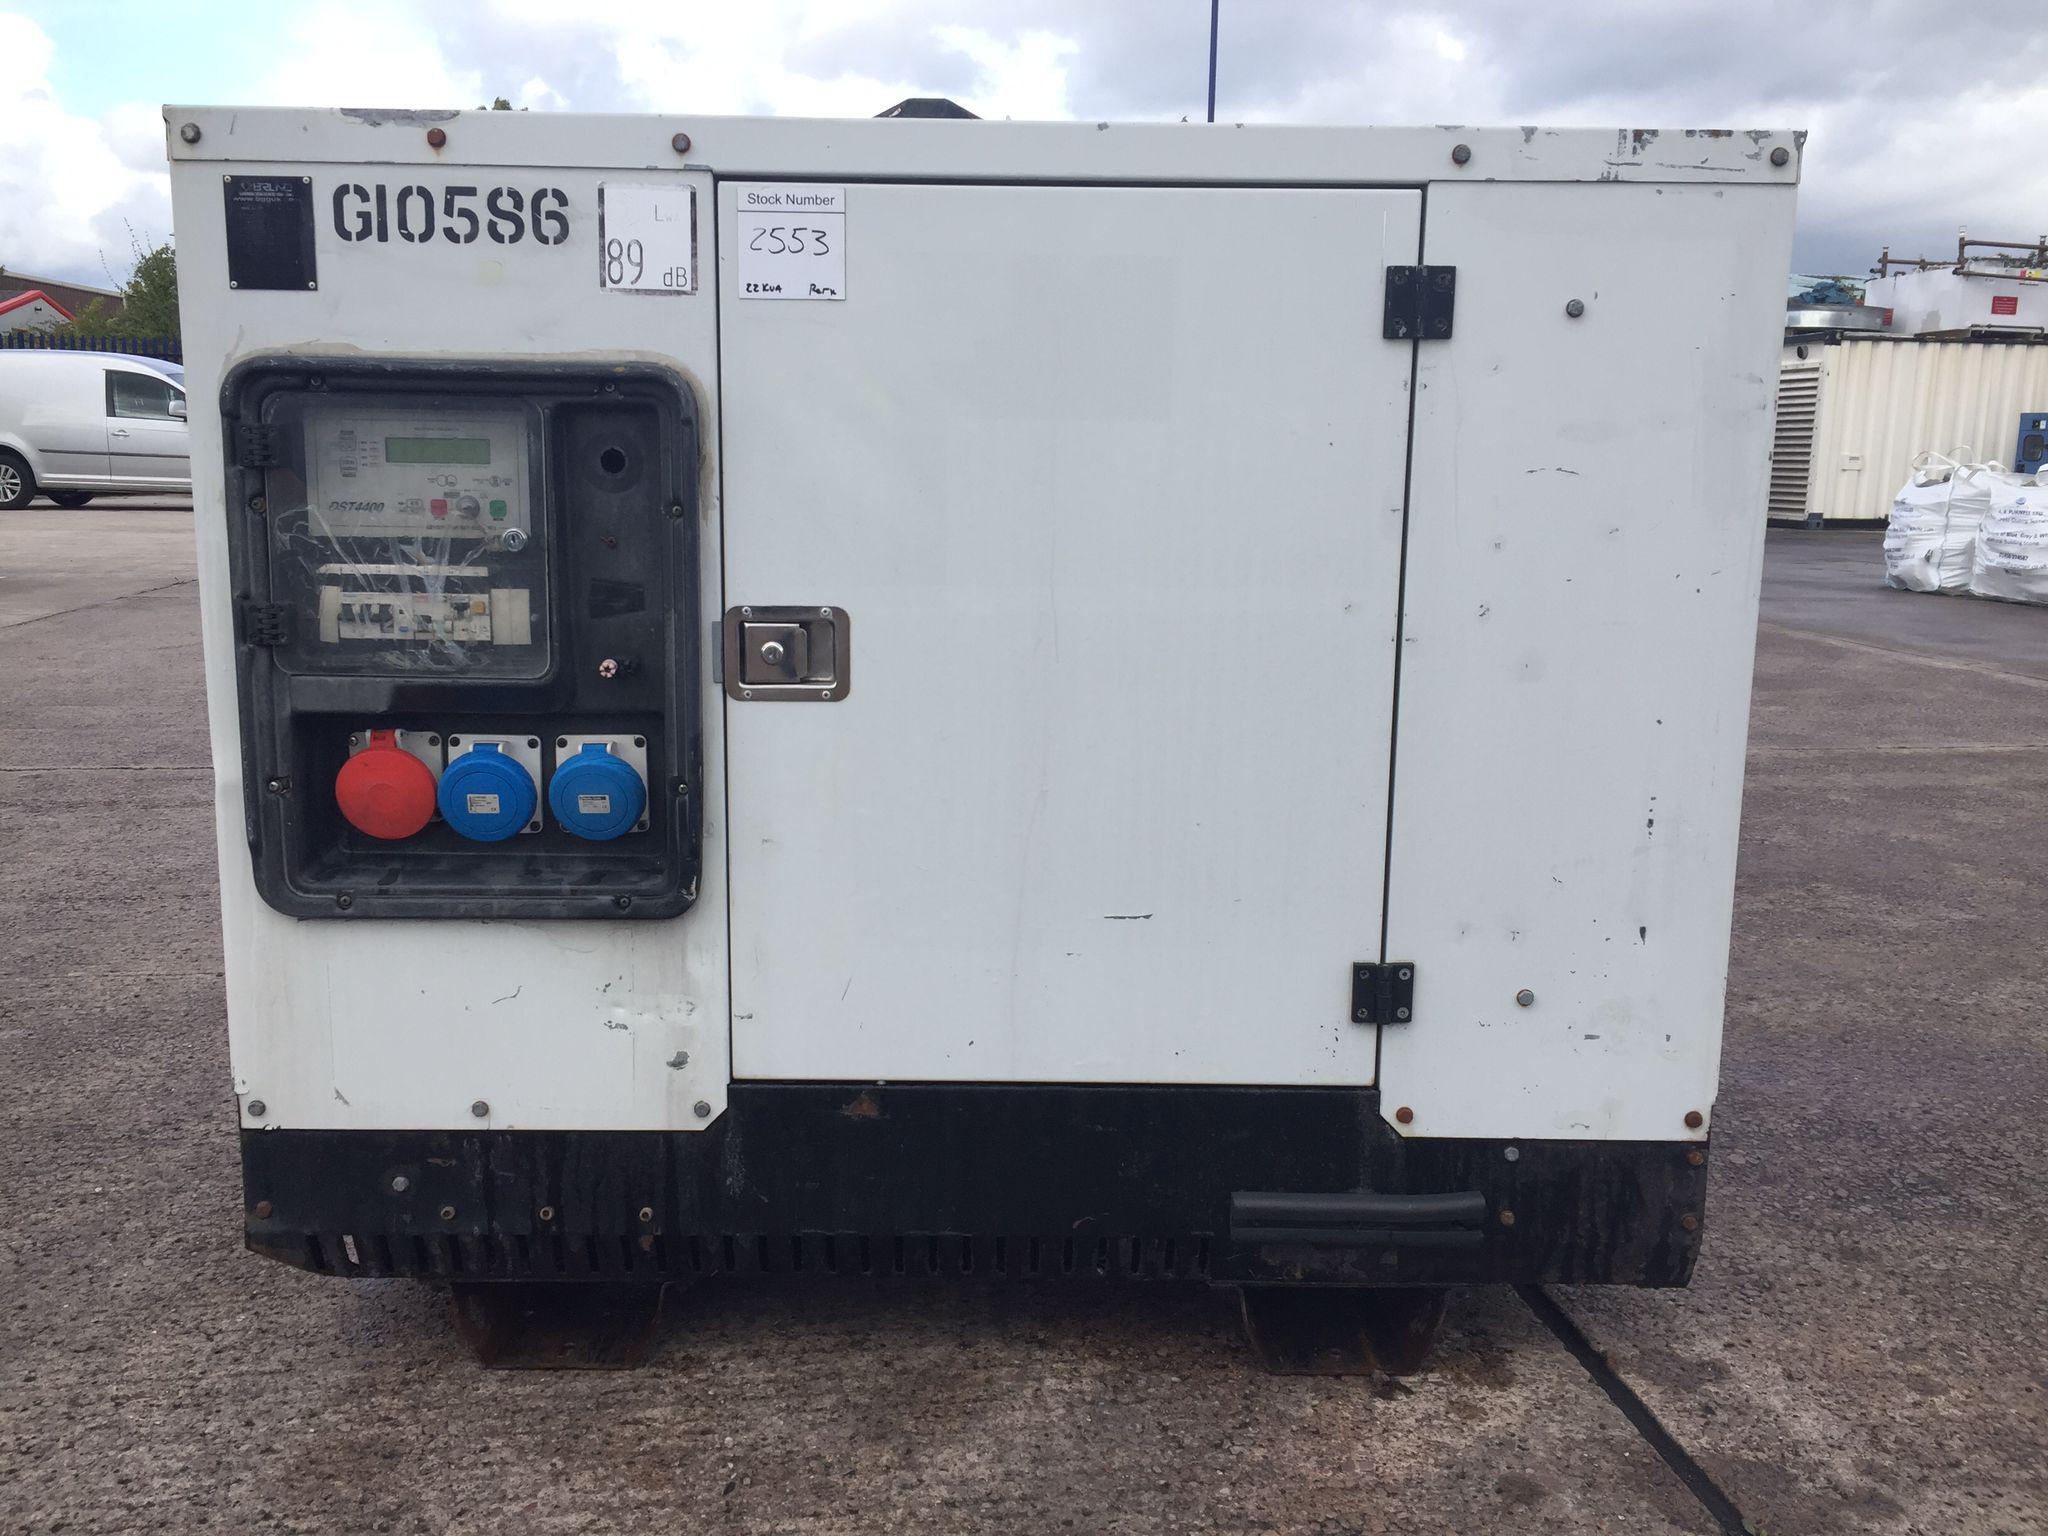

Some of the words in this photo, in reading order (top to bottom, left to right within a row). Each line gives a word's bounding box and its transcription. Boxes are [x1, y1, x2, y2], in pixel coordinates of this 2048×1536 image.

[747, 193, 782, 205] Stock
[786, 194, 835, 206] Number
[750, 227, 829, 256] 2553
[607, 238, 643, 285] 89
[663, 266, 687, 287] dB
